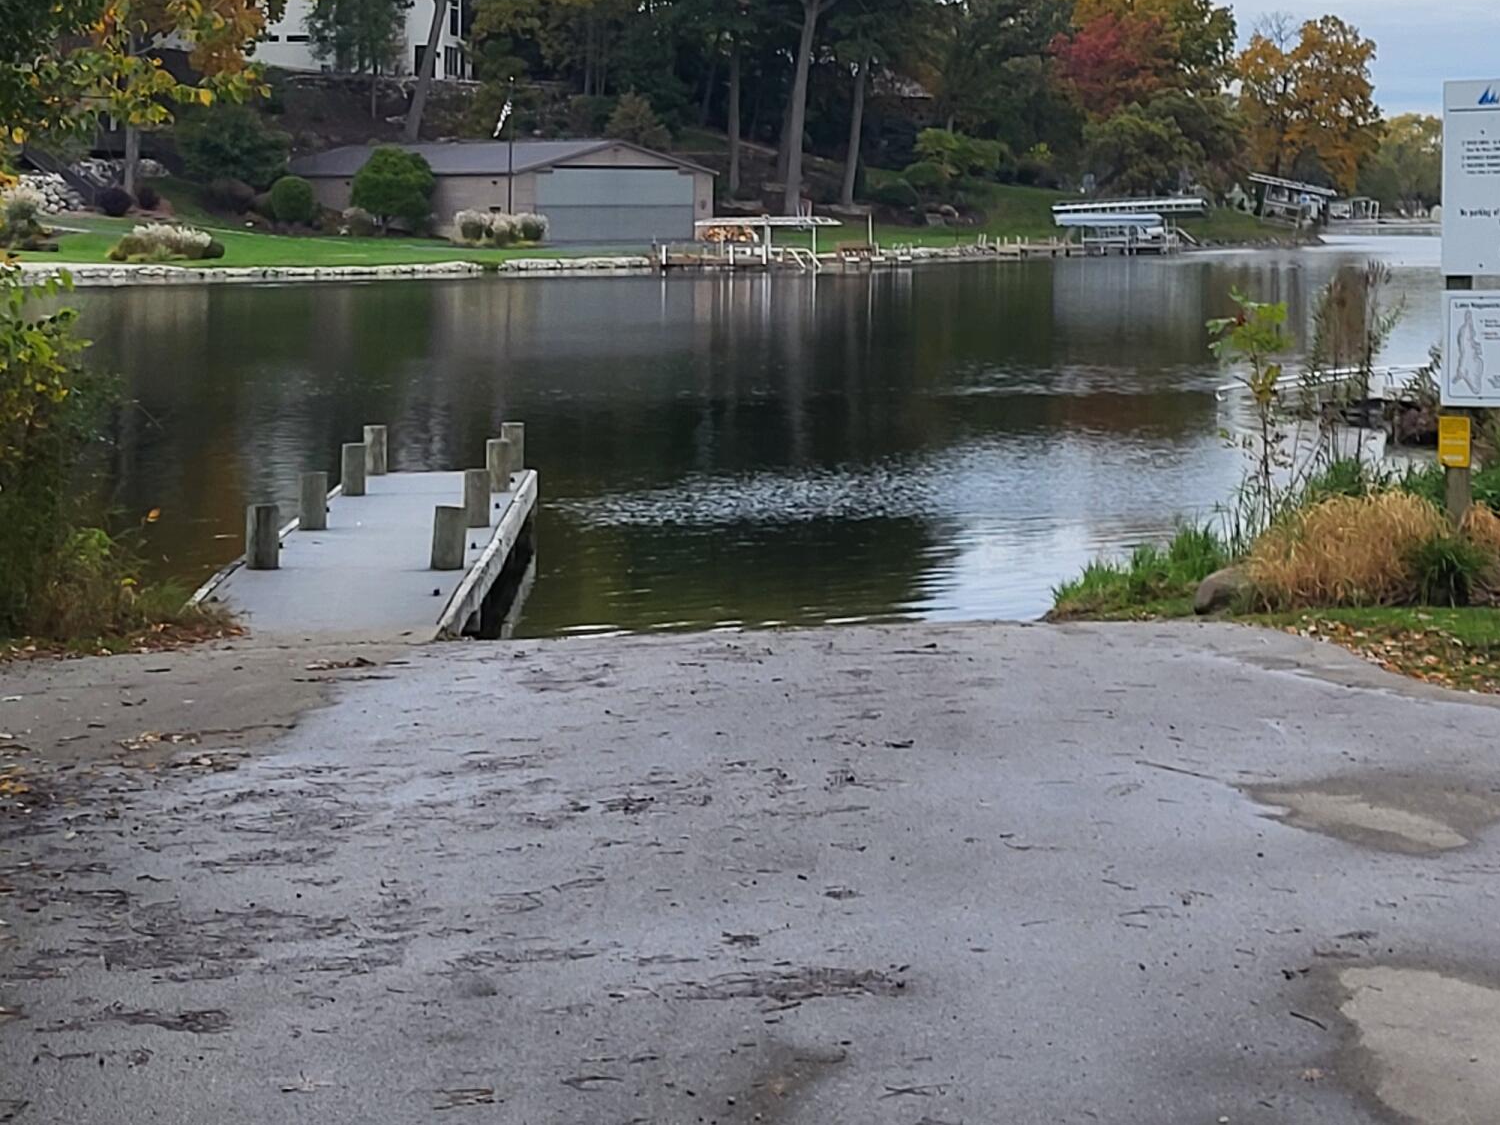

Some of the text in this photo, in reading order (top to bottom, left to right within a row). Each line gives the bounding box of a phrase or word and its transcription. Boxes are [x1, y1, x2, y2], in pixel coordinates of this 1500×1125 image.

[1460, 209, 1468, 217] No
[1469, 209, 1491, 218] parking
[1493, 208, 1500, 216] of
